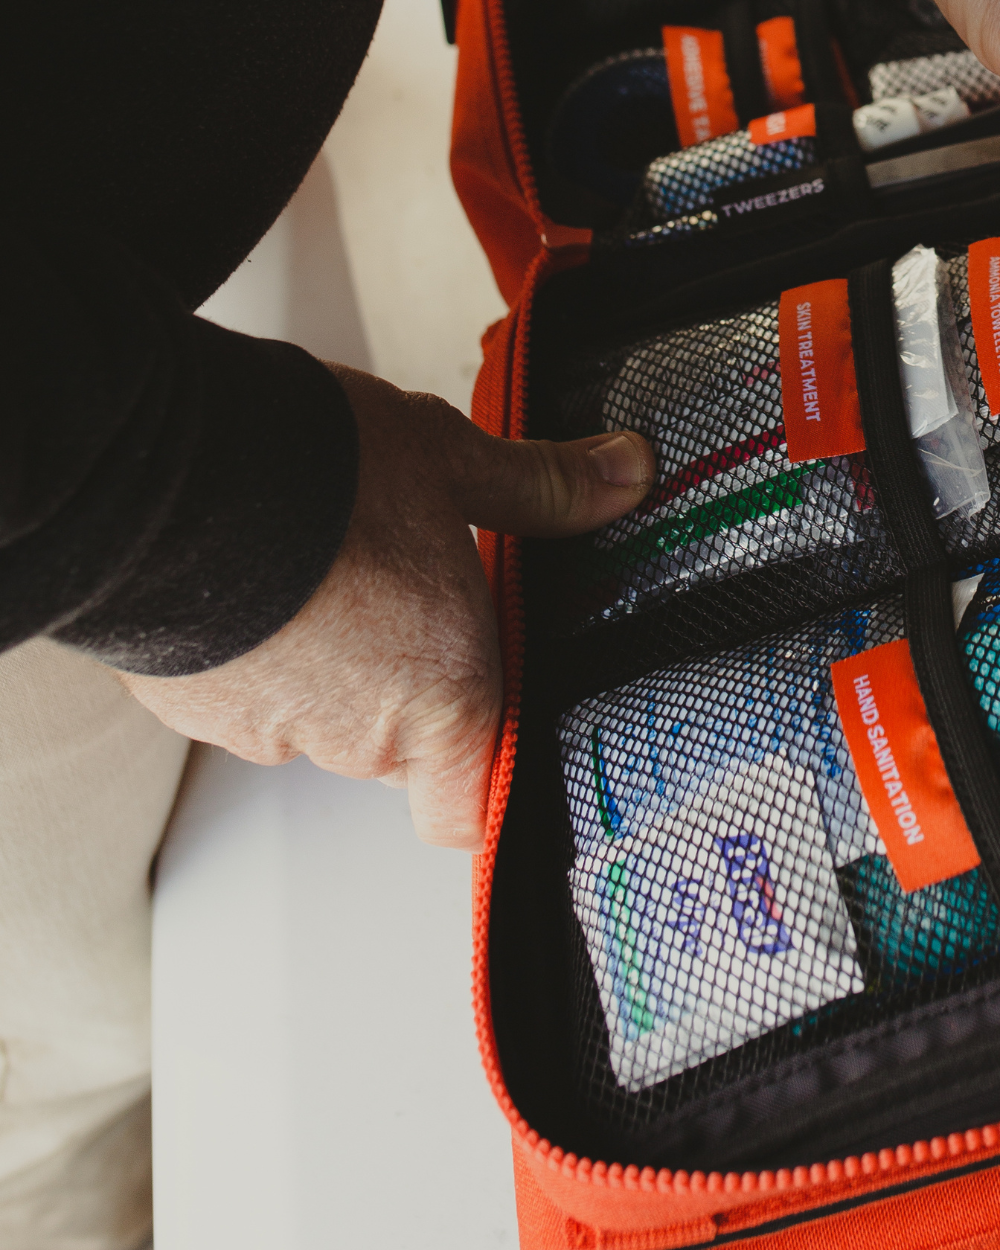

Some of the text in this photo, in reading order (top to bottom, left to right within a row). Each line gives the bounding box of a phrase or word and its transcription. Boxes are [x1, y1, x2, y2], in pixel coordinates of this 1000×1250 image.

[721, 177, 825, 218] TWEEZERS
[796, 302, 821, 422] SKIN TREATMENT
[853, 674, 925, 845] HAND SANITATION
